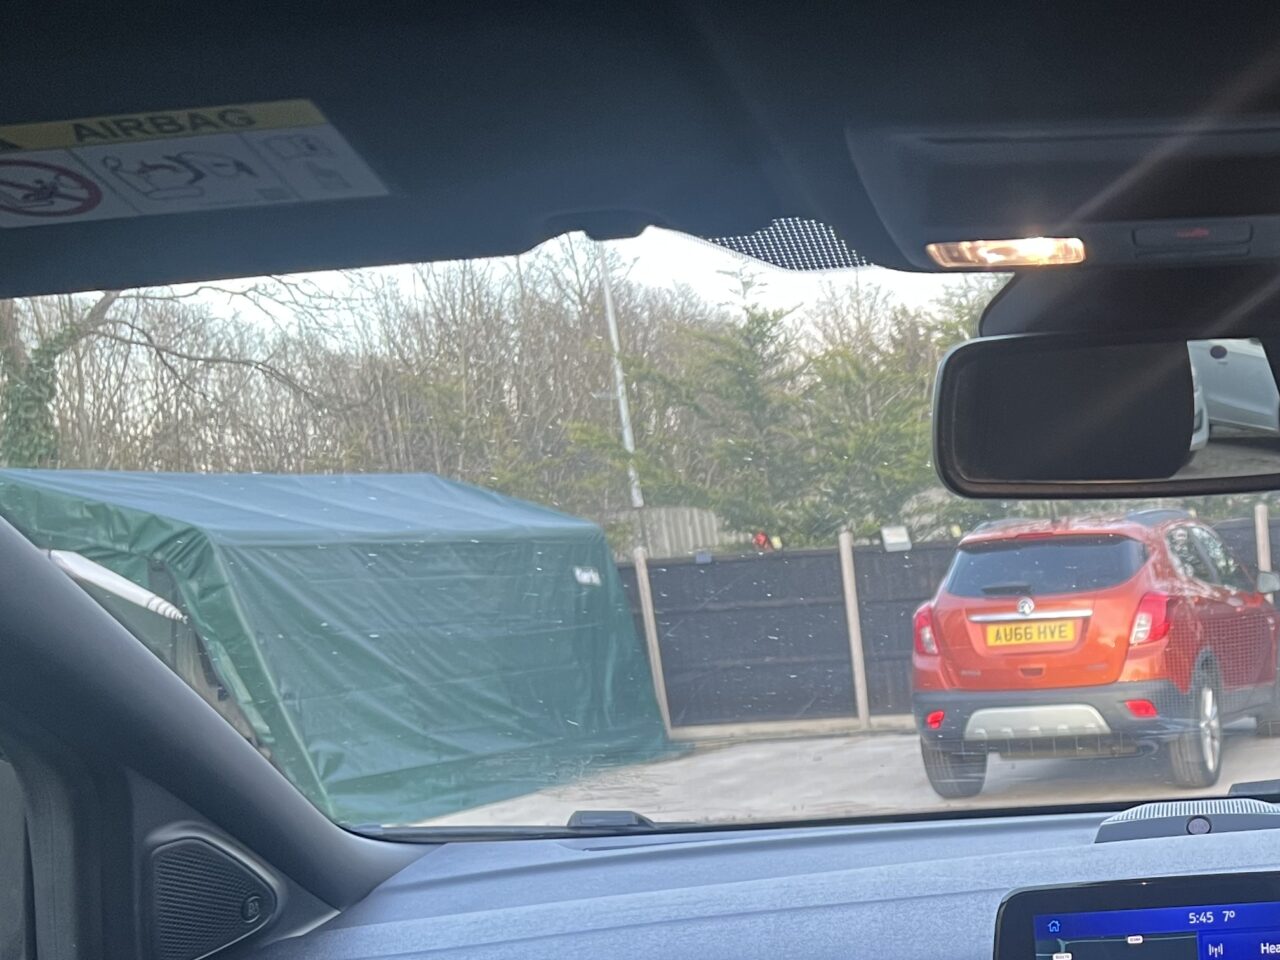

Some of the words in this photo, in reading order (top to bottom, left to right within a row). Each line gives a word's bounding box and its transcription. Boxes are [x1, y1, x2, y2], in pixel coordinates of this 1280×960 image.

[70, 108, 257, 144] AIRBAG
[994, 624, 1033, 643] AU66
[1037, 623, 1069, 640] HVE
[1188, 911, 1214, 924] 5:45
